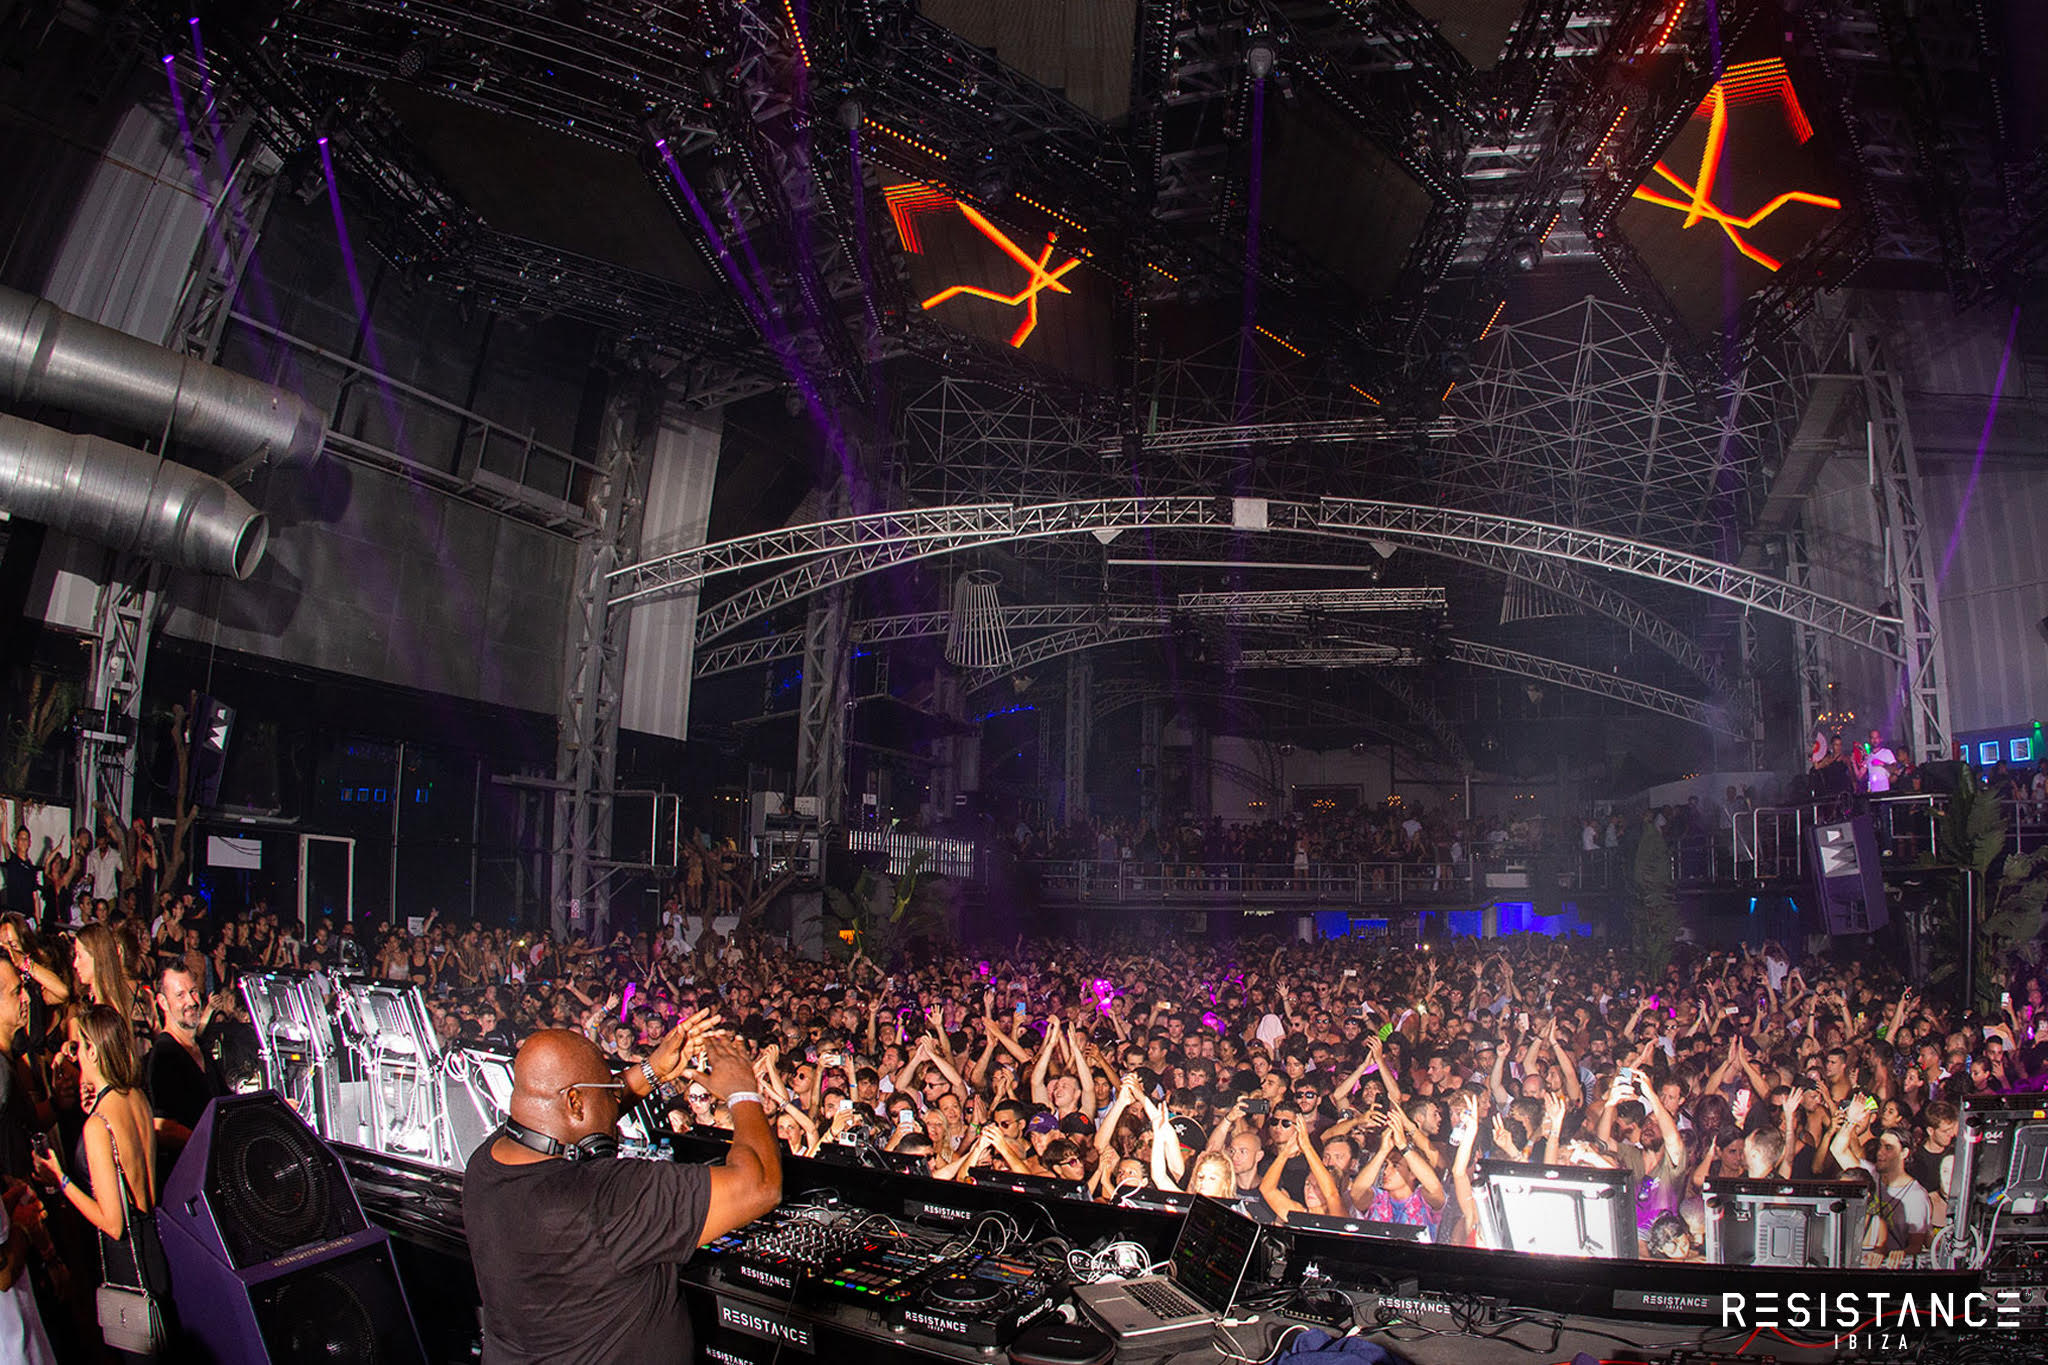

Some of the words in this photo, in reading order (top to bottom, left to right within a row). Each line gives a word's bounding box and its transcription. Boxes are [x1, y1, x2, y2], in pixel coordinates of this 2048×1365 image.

[924, 1204, 971, 1220] RESISTANCE
[740, 1265, 791, 1288] RESISTANCE
[1378, 1297, 1451, 1314] RESISTANCE
[1642, 1294, 1708, 1308] RESISTANCE
[723, 1307, 808, 1345] RESISTANCE
[905, 1310, 968, 1334] RESISTANCE
